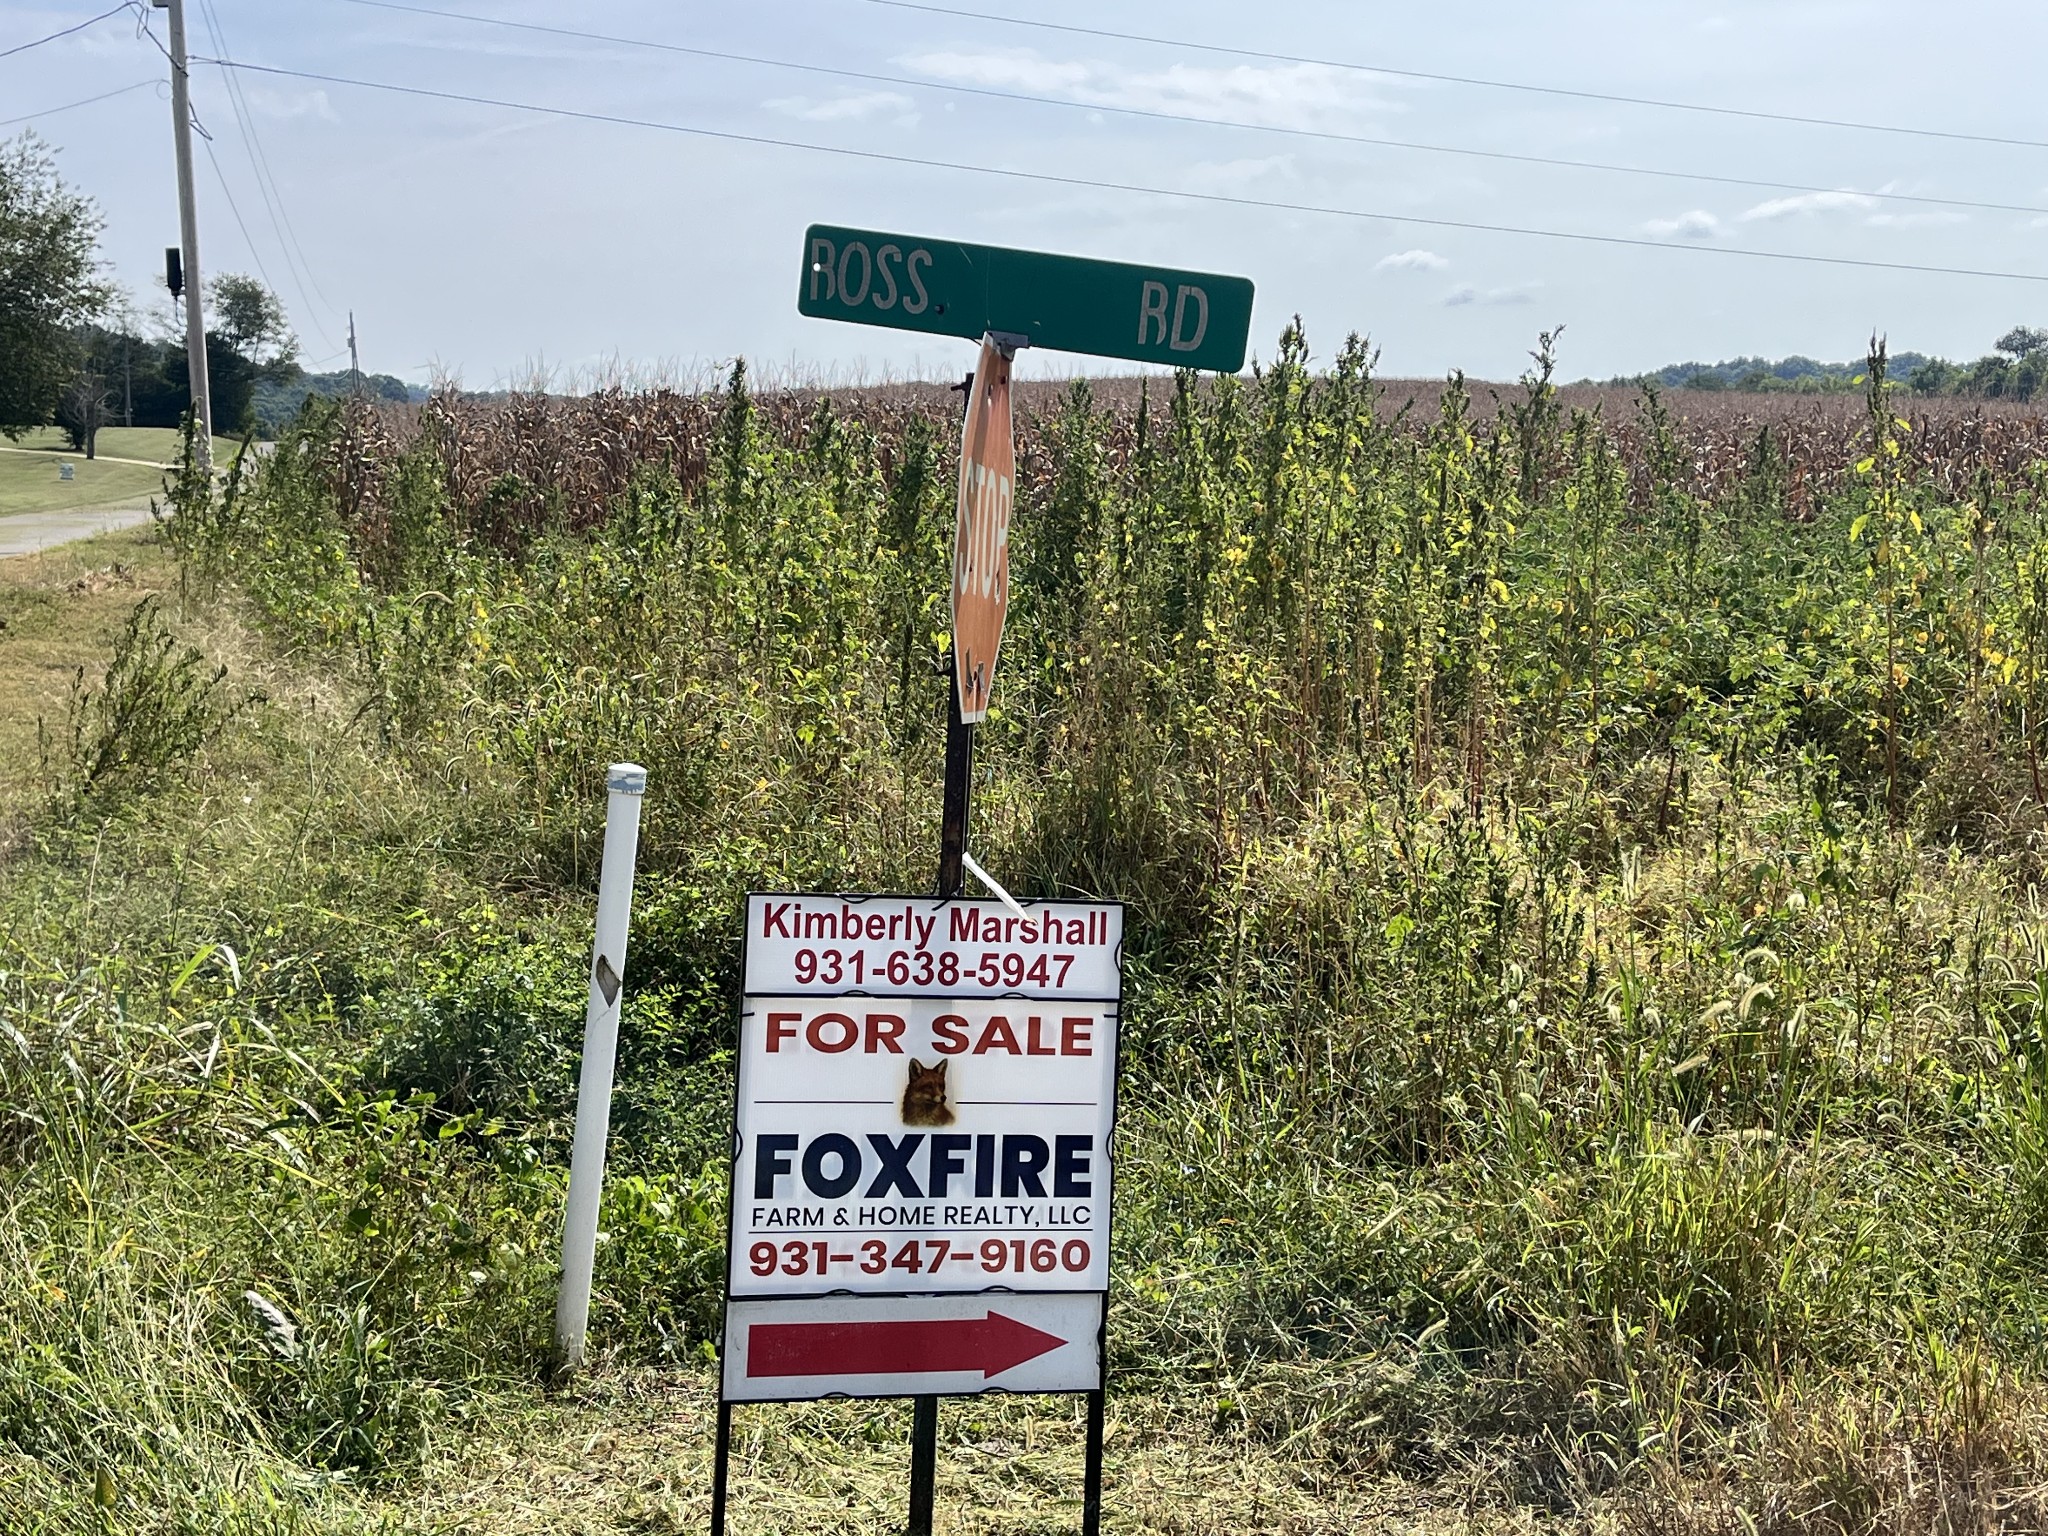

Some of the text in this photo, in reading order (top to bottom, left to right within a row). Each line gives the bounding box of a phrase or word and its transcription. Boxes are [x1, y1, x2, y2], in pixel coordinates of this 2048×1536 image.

[810, 238, 1209, 352] ROSS RD
[959, 457, 1011, 606] STOP
[763, 902, 1107, 950] Kimberly Marshall
[794, 948, 1075, 988] 931-638-5947
[765, 1012, 1094, 1056] FOR SALE
[754, 1133, 1094, 1199] FOXFIRE
[751, 1205, 1091, 1228] FARM & HOME REALTY, LLC
[749, 1239, 1091, 1276] 931-347-9160
